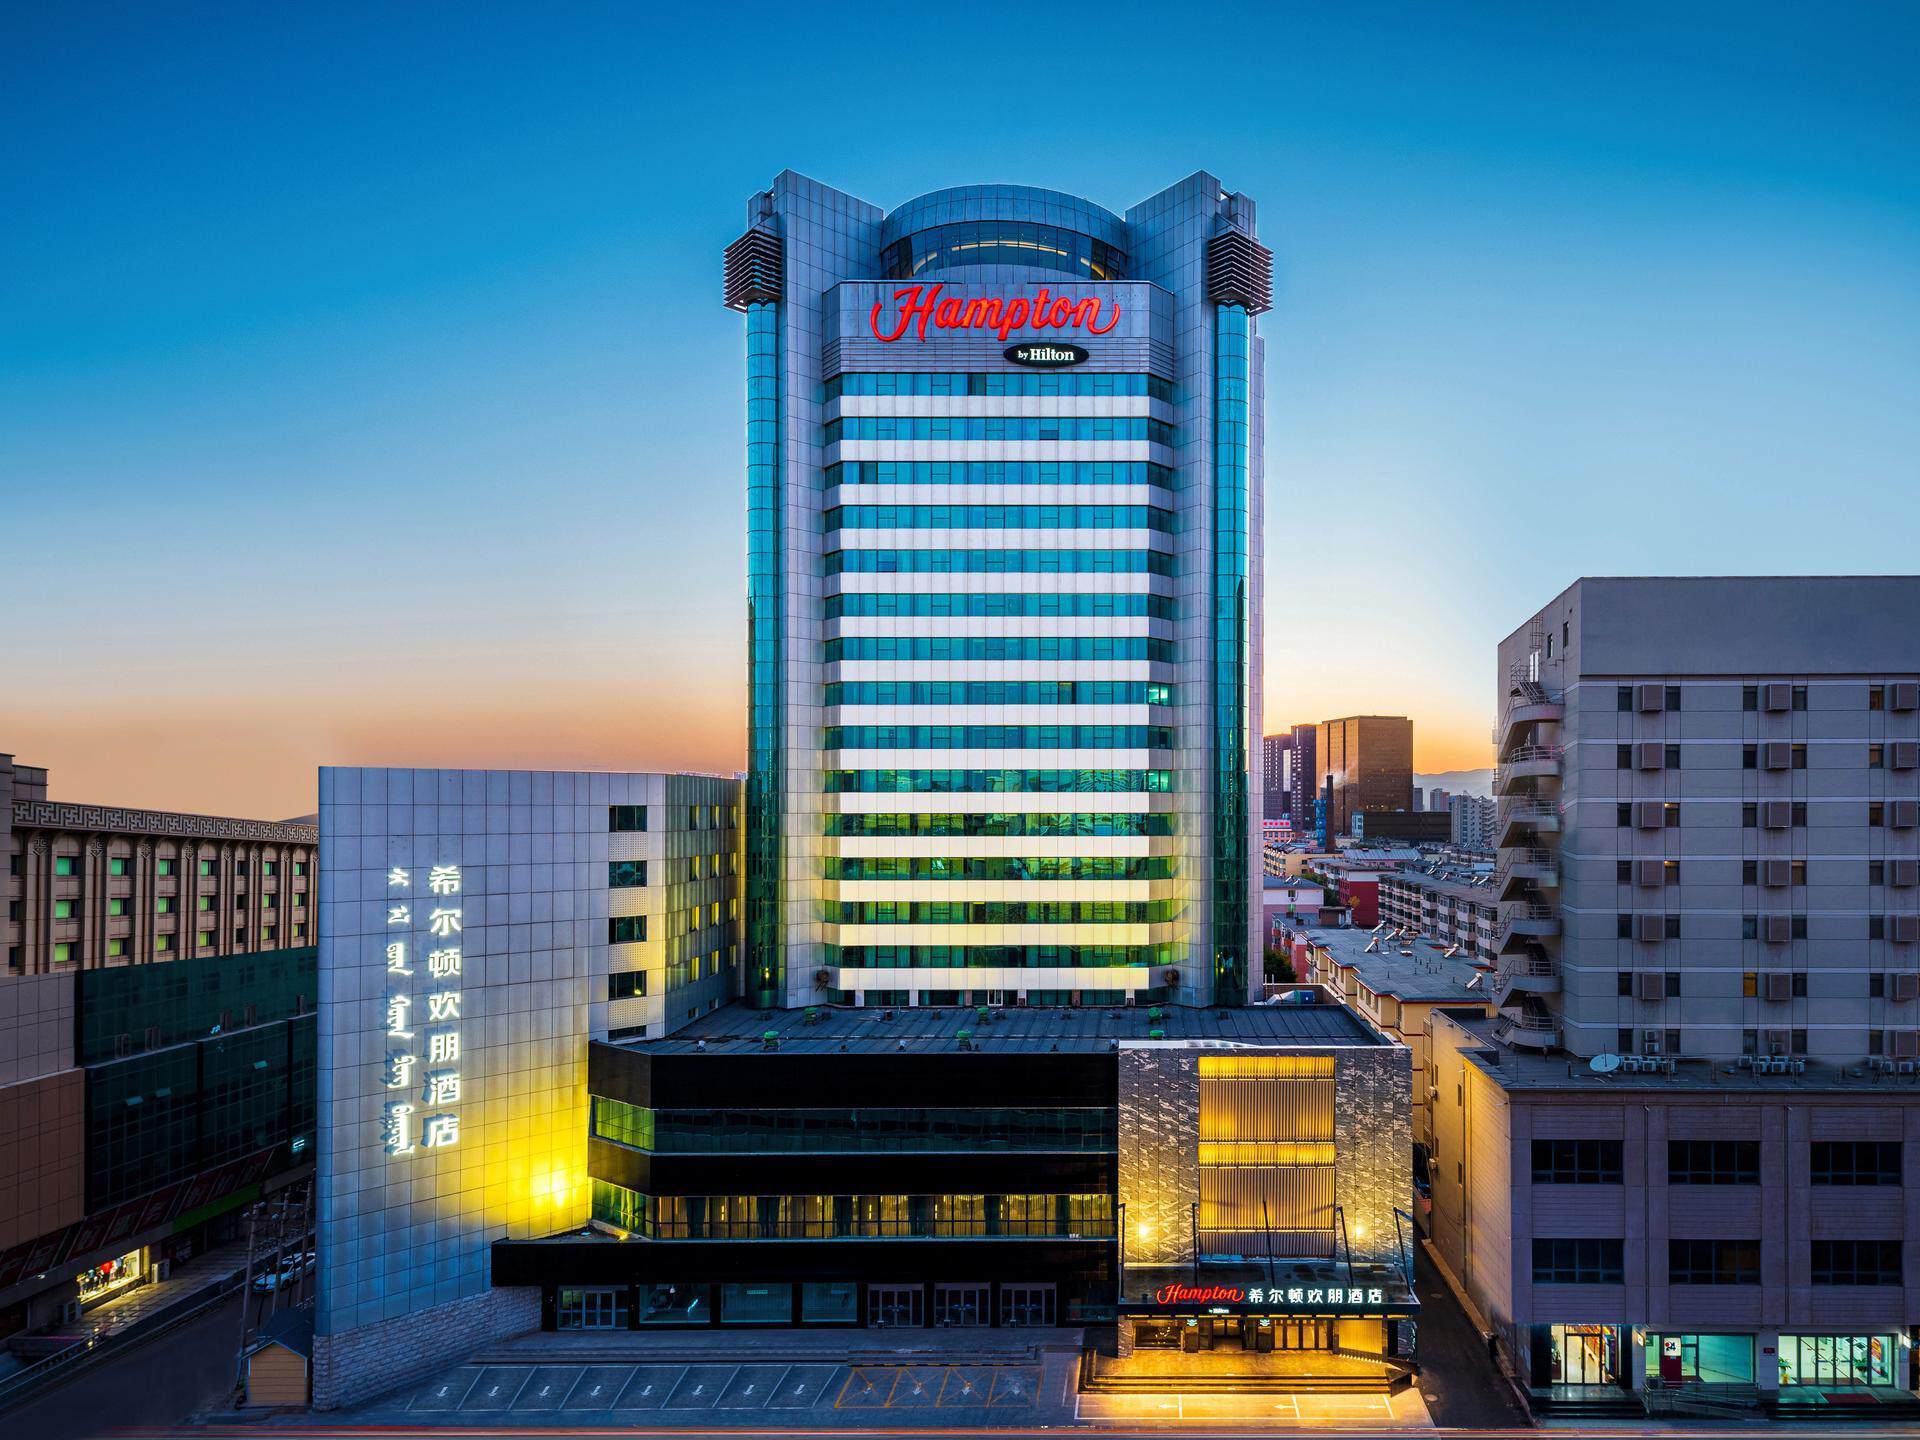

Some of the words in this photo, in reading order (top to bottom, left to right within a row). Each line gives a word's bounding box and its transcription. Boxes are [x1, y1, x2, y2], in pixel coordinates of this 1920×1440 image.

[870, 283, 1121, 342] Hampton
[1017, 350, 1029, 360] by
[1029, 347, 1075, 361] Hilton
[428, 865, 462, 1149] 希尔顿欢朋酒店
[1156, 1283, 1245, 1304] Hampton
[1248, 1288, 1383, 1304] 希尔顿欢朋酒店
